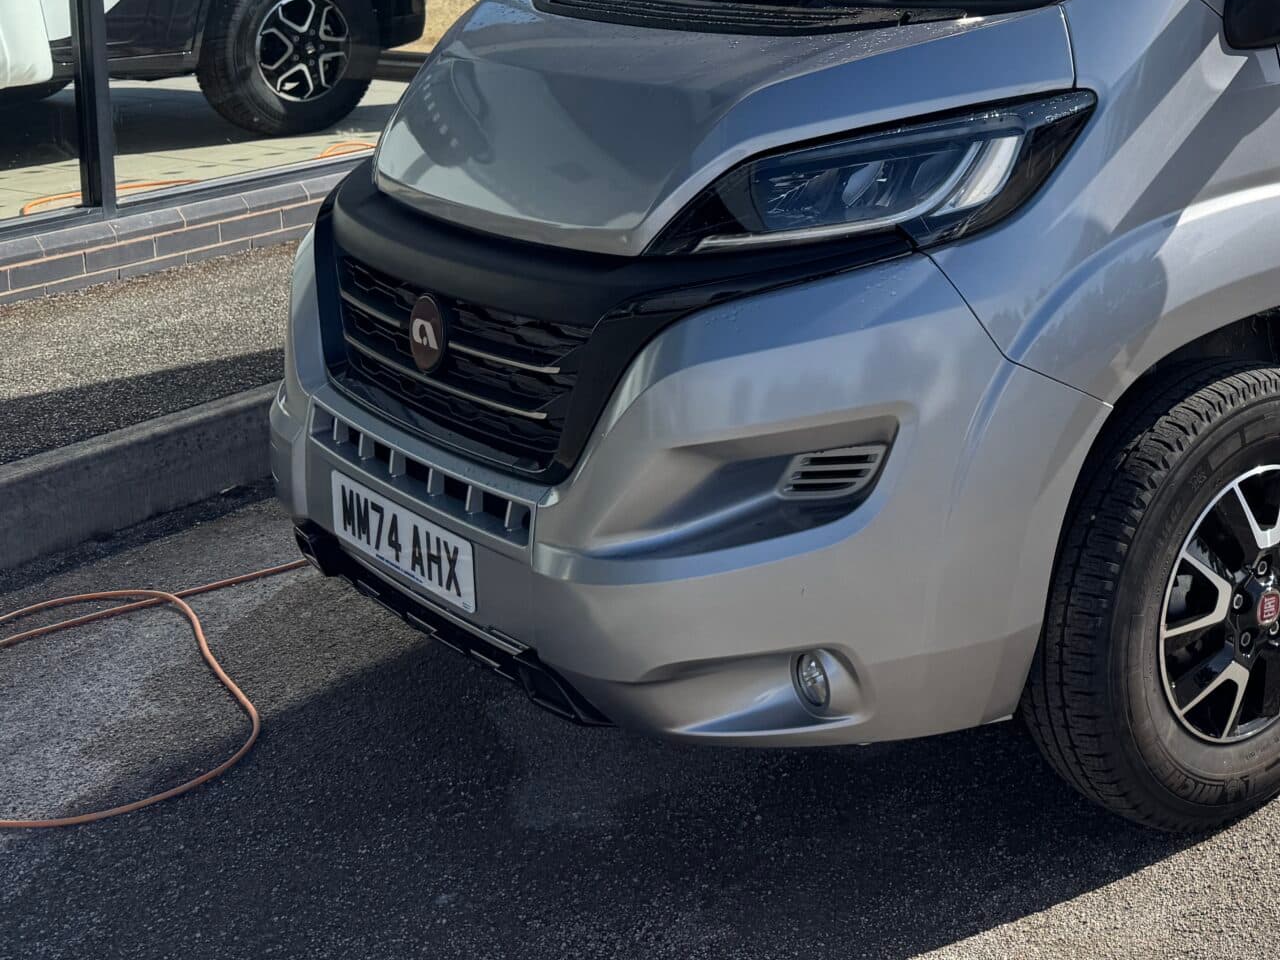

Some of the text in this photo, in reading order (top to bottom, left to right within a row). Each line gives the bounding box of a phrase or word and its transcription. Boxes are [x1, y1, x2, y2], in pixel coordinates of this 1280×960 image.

[341, 484, 402, 563] MM74
[411, 524, 462, 597] AHX
[1263, 596, 1277, 618] FIAT
